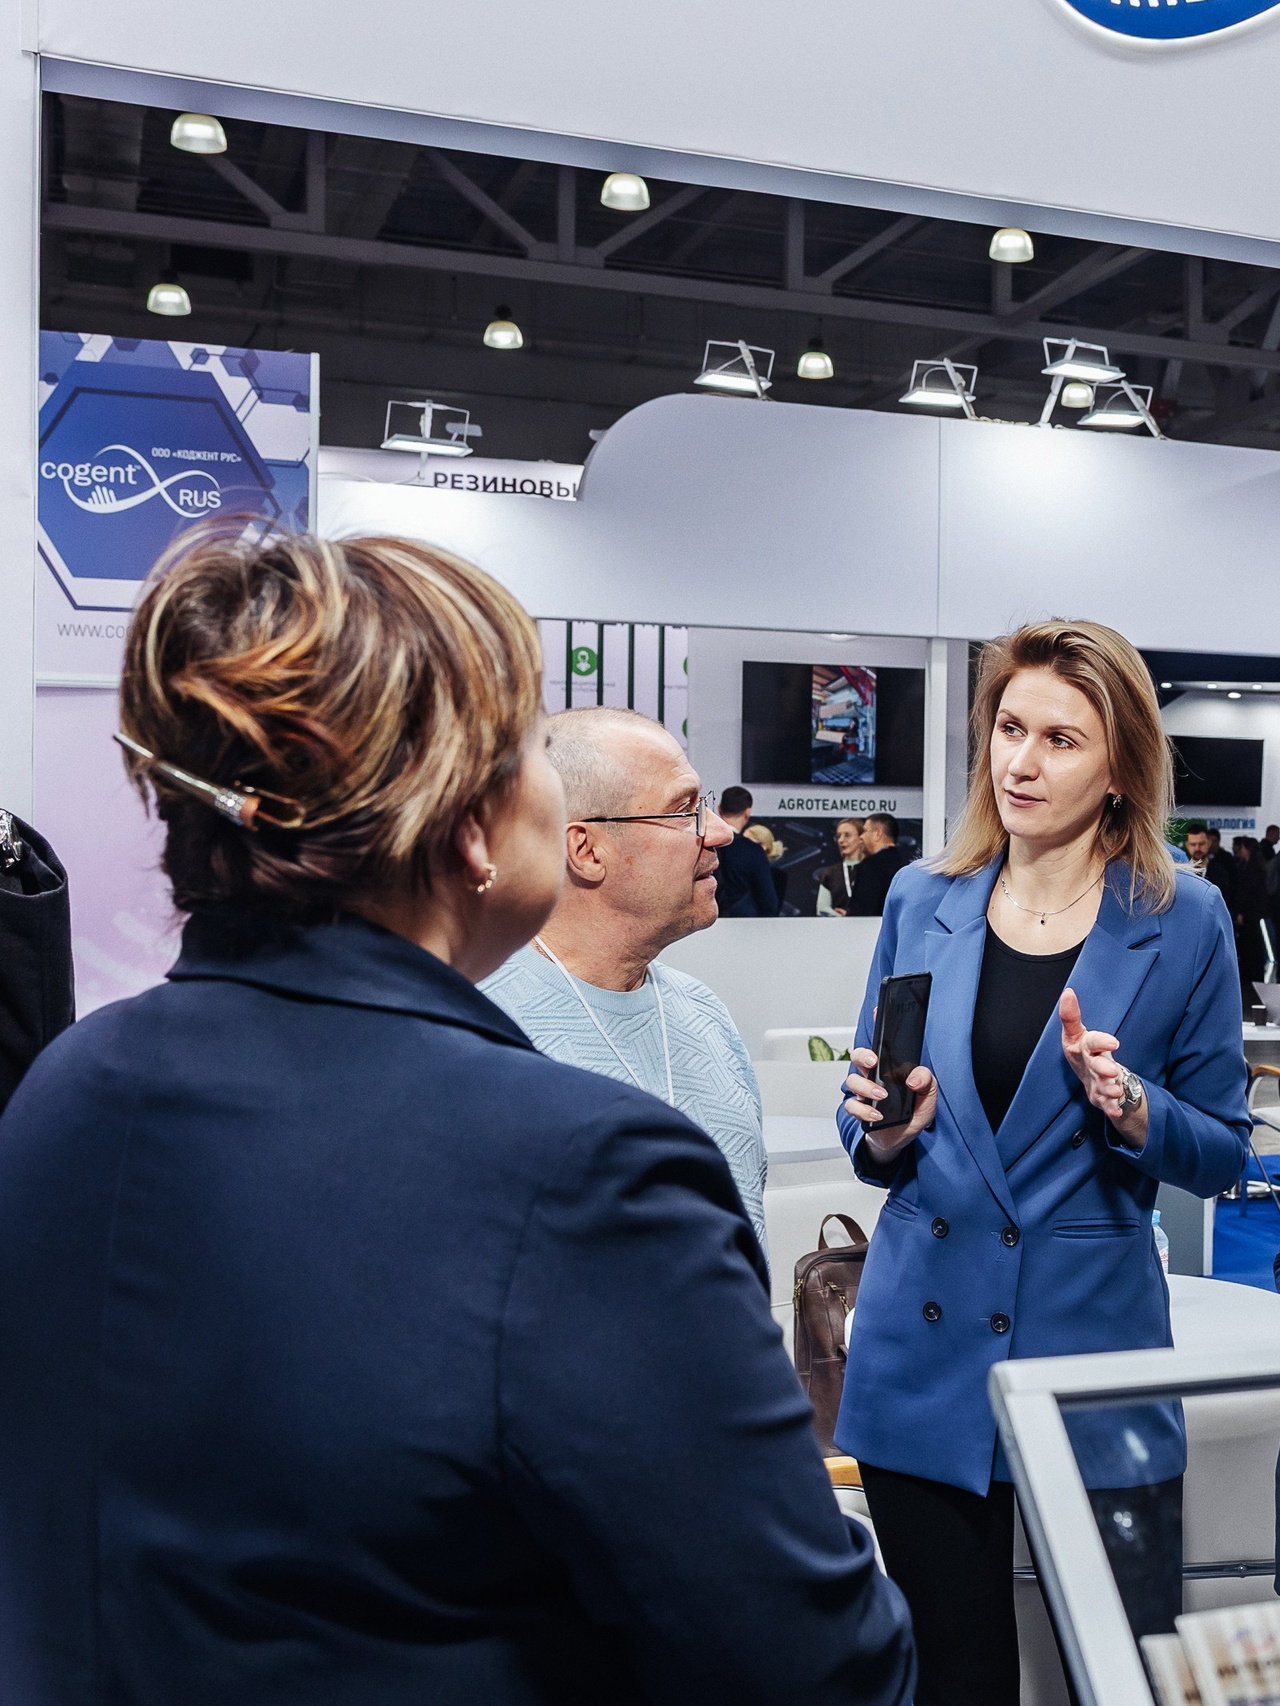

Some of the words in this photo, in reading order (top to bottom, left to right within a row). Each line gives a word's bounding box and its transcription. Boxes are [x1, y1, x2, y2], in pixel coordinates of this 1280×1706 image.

[40, 461, 138, 487] cogent
[179, 488, 221, 509] RUS
[778, 798, 897, 812] AGROTEAMECO.RU
